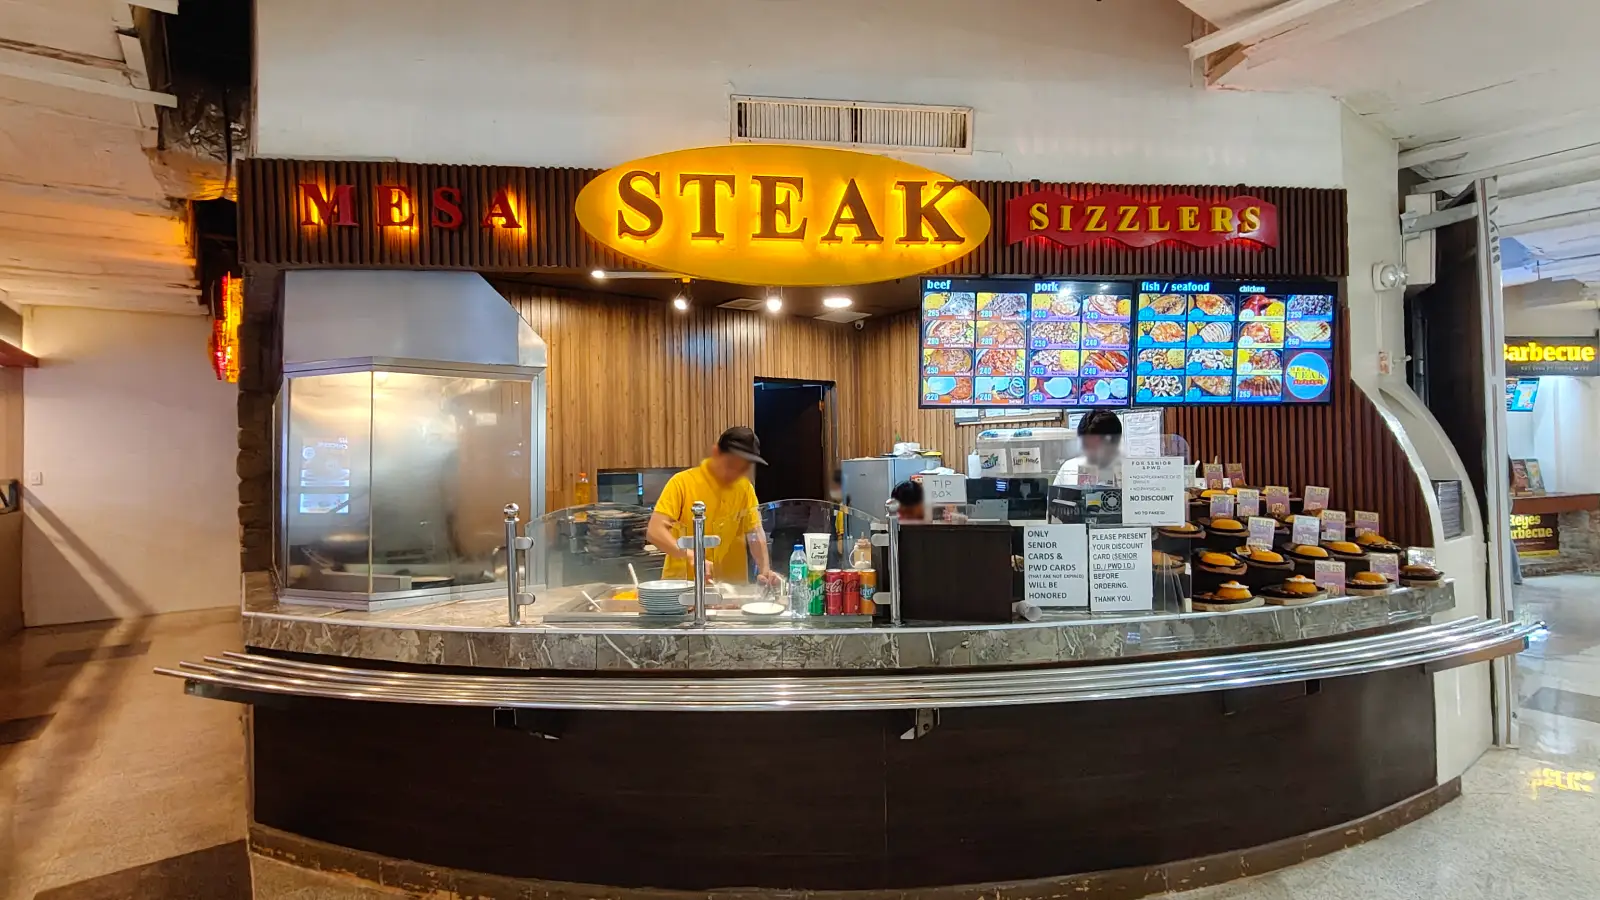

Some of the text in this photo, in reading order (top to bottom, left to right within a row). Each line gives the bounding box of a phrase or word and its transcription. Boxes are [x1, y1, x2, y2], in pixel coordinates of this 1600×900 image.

[299, 183, 523, 229] MESA
[617, 170, 966, 246] STEAK
[1029, 202, 1262, 233] SIZZLERS
[926, 280, 951, 290] beef
[1034, 282, 1059, 292] pork
[1141, 282, 1160, 291] fish
[1171, 282, 1210, 292] seafood
[932, 480, 952, 488] TIP
[1510, 514, 1541, 528] Reyes
[1027, 530, 1049, 538] ONLY
[1117, 532, 1147, 540] PRESENT
[1511, 528, 1554, 540] rbecue
[1027, 541, 1058, 549] SENIOR
[1111, 542, 1144, 550] DISCOUNT
[1027, 552, 1055, 560] CARDS
[1112, 552, 1138, 560] (SENIOR
[1028, 581, 1047, 589] WILL
